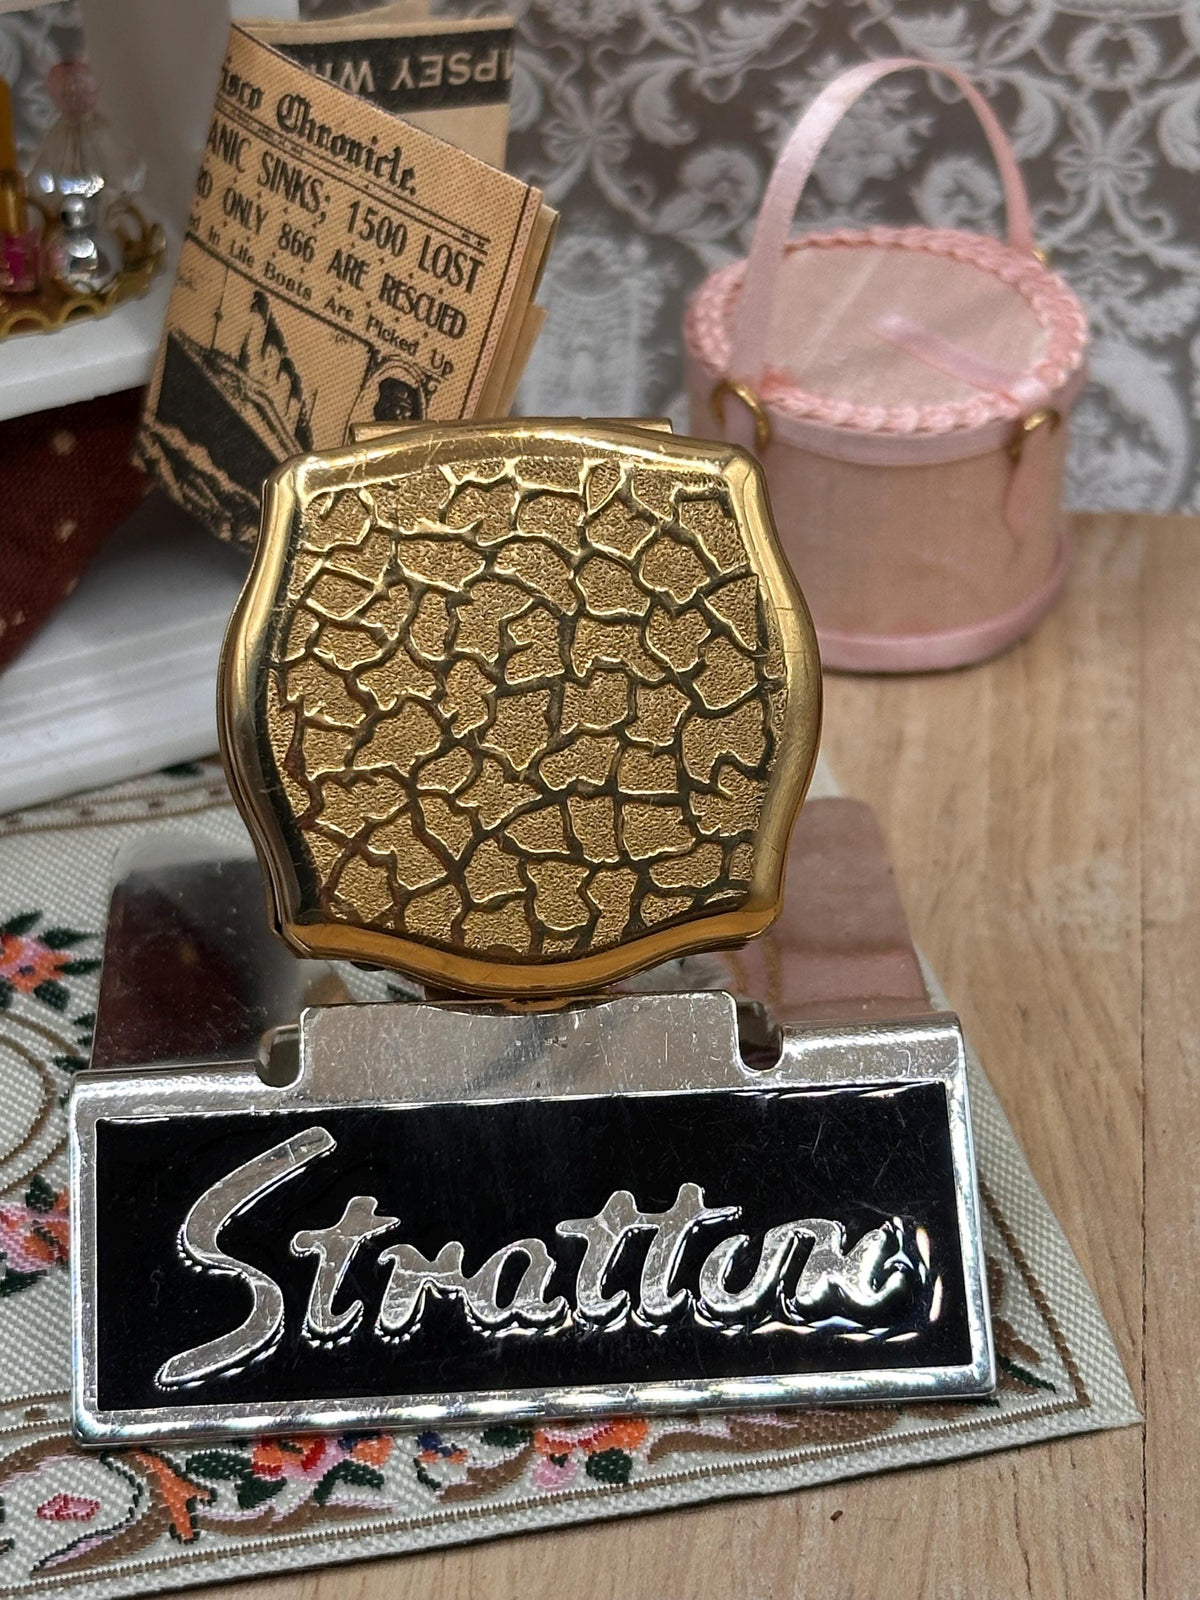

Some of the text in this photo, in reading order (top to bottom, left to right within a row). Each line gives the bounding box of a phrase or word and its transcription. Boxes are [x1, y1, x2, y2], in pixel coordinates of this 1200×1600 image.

[276, 93, 417, 196] Chronicle.
[223, 187, 269, 235] ONLY
[278, 222, 317, 263] 866
[327, 248, 371, 292] ARE
[379, 272, 467, 340] RESCUED
[229, 239, 255, 268] Life
[263, 260, 312, 301] Boats
[324, 296, 354, 322] Are
[366, 313, 419, 356] Picked
[431, 347, 455, 376] Up
[347, 200, 408, 257] 1500
[418, 234, 485, 294] LOST
[154, 1126, 932, 1390] Stratton
